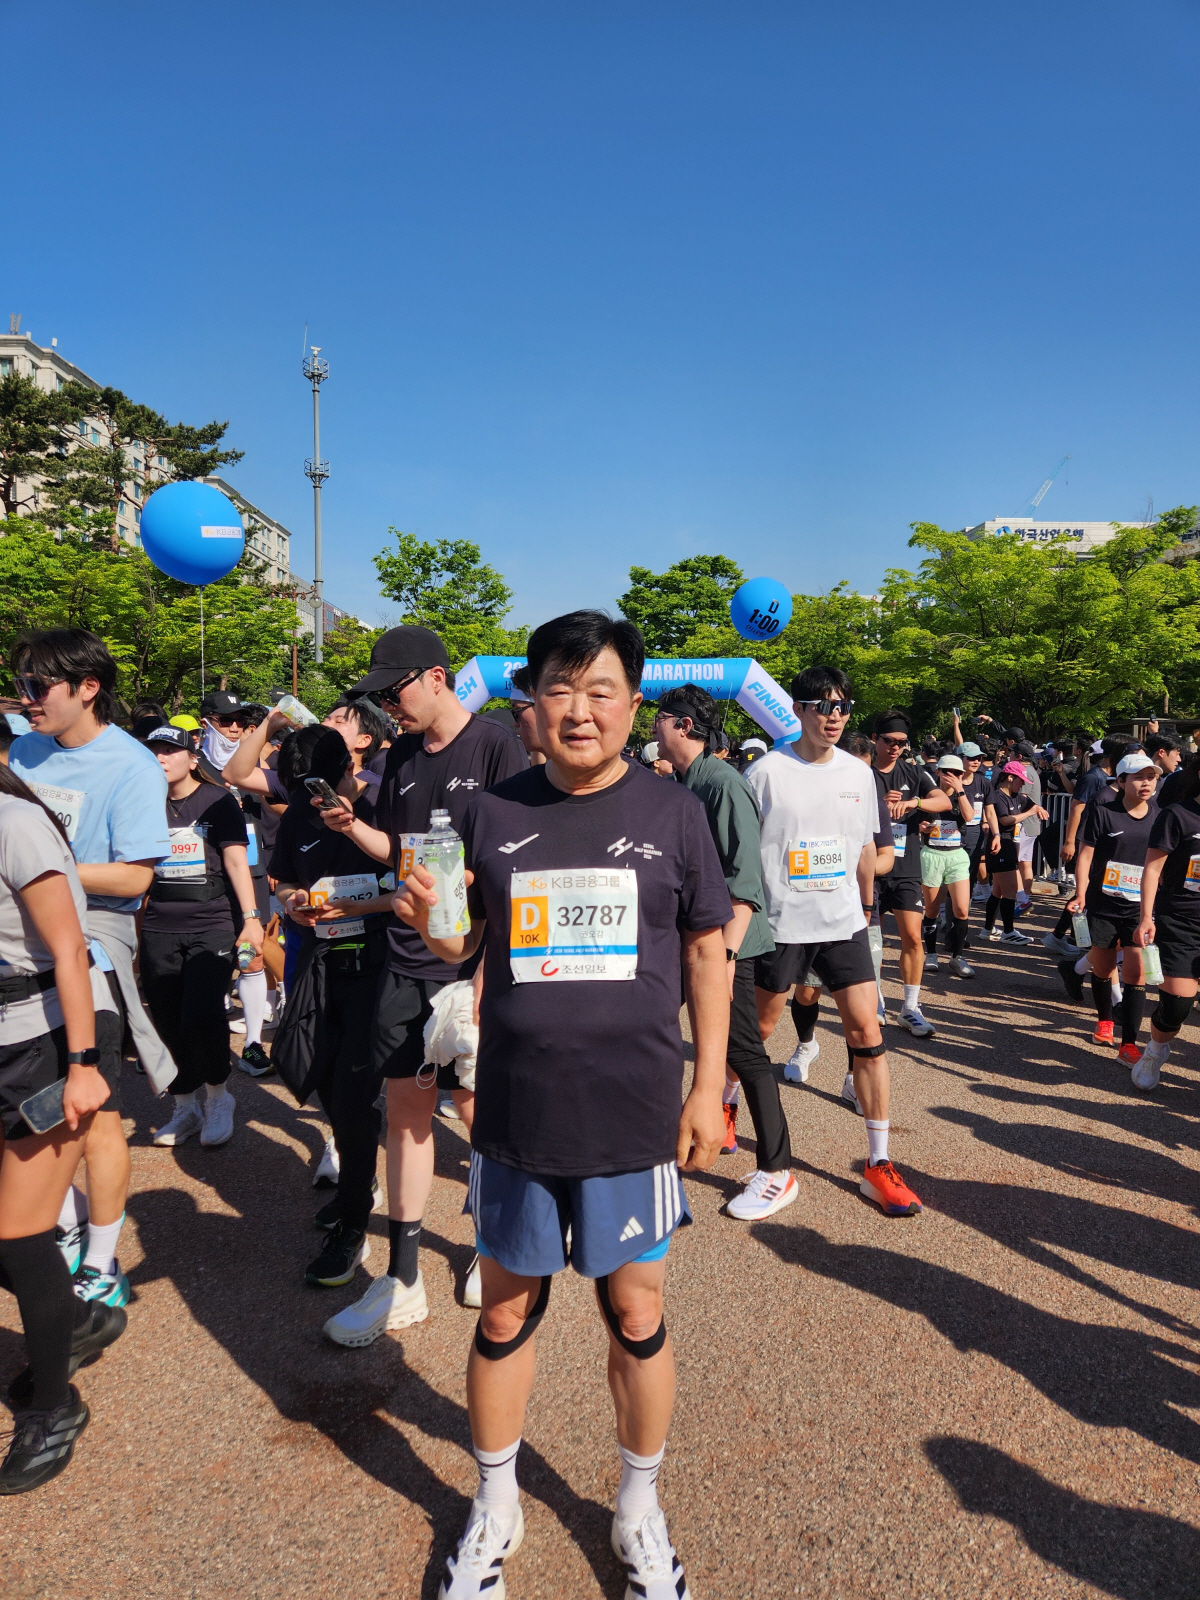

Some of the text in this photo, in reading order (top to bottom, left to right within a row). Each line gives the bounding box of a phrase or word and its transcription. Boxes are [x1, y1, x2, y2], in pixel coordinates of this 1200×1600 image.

[749, 609, 779, 633] 1:00
[642, 663, 724, 681] MARATHON
[747, 681, 797, 728] FINISH
[36, 787, 74, 803] KB금융그룹
[57, 812, 72, 828] 00
[171, 843, 198, 854] 0997
[404, 852, 411, 871] E
[794, 853, 843, 868] E 36984
[328, 877, 368, 888] KB금융그룹
[551, 875, 621, 889] KB금융그룹
[1107, 870, 1118, 881] D
[520, 902, 627, 931] D 32787
[520, 934, 540, 944] 10K
[561, 964, 607, 974] 조선일보
